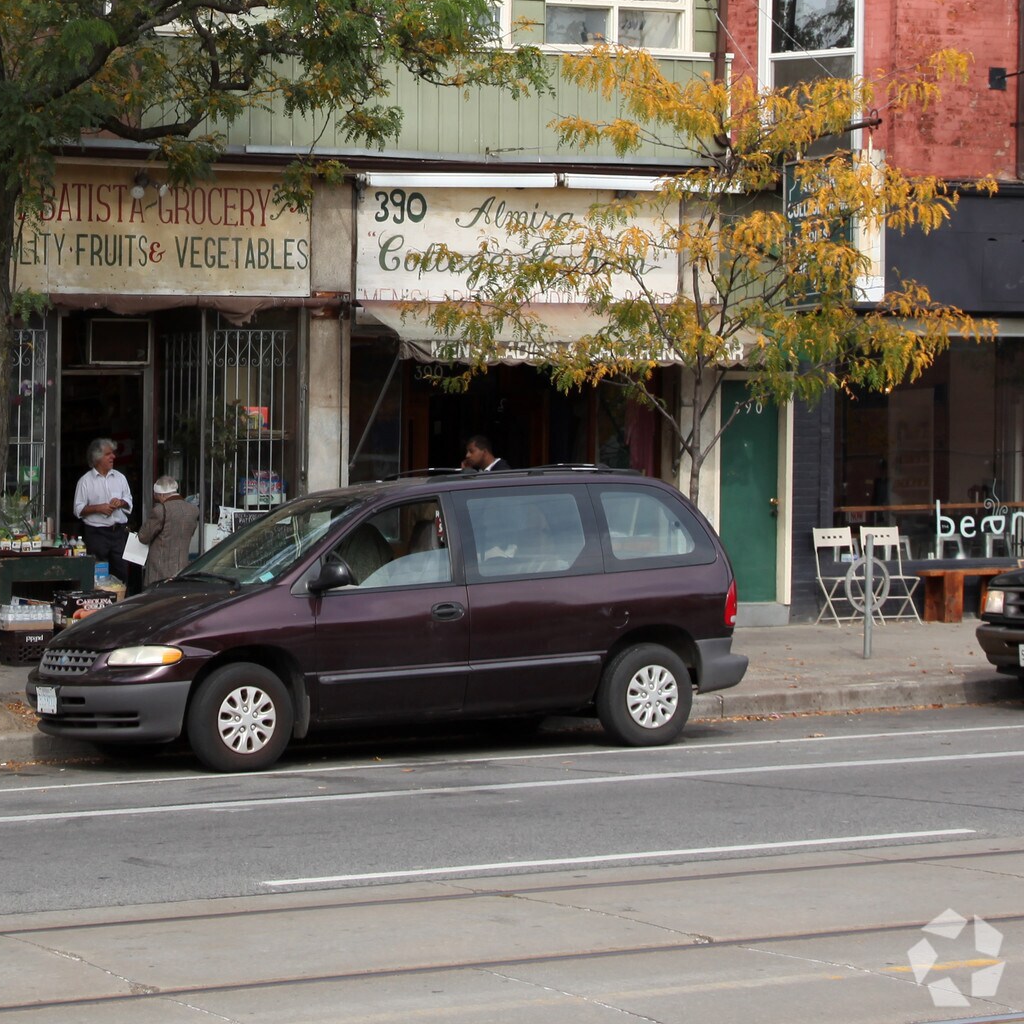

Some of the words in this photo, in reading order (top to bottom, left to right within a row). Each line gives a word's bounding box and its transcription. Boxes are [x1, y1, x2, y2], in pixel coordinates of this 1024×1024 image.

[38, 182, 145, 223] BATISTA
[157, 185, 271, 226] GROCERY
[374, 188, 428, 224] 390
[455, 195, 575, 229] Almira
[10, 232, 65, 265] LITY
[76, 233, 148, 267] FRUITS
[148, 241, 166, 264] &
[175, 235, 309, 270] VEGETABLES
[76, 598, 113, 606] CAROLINA
